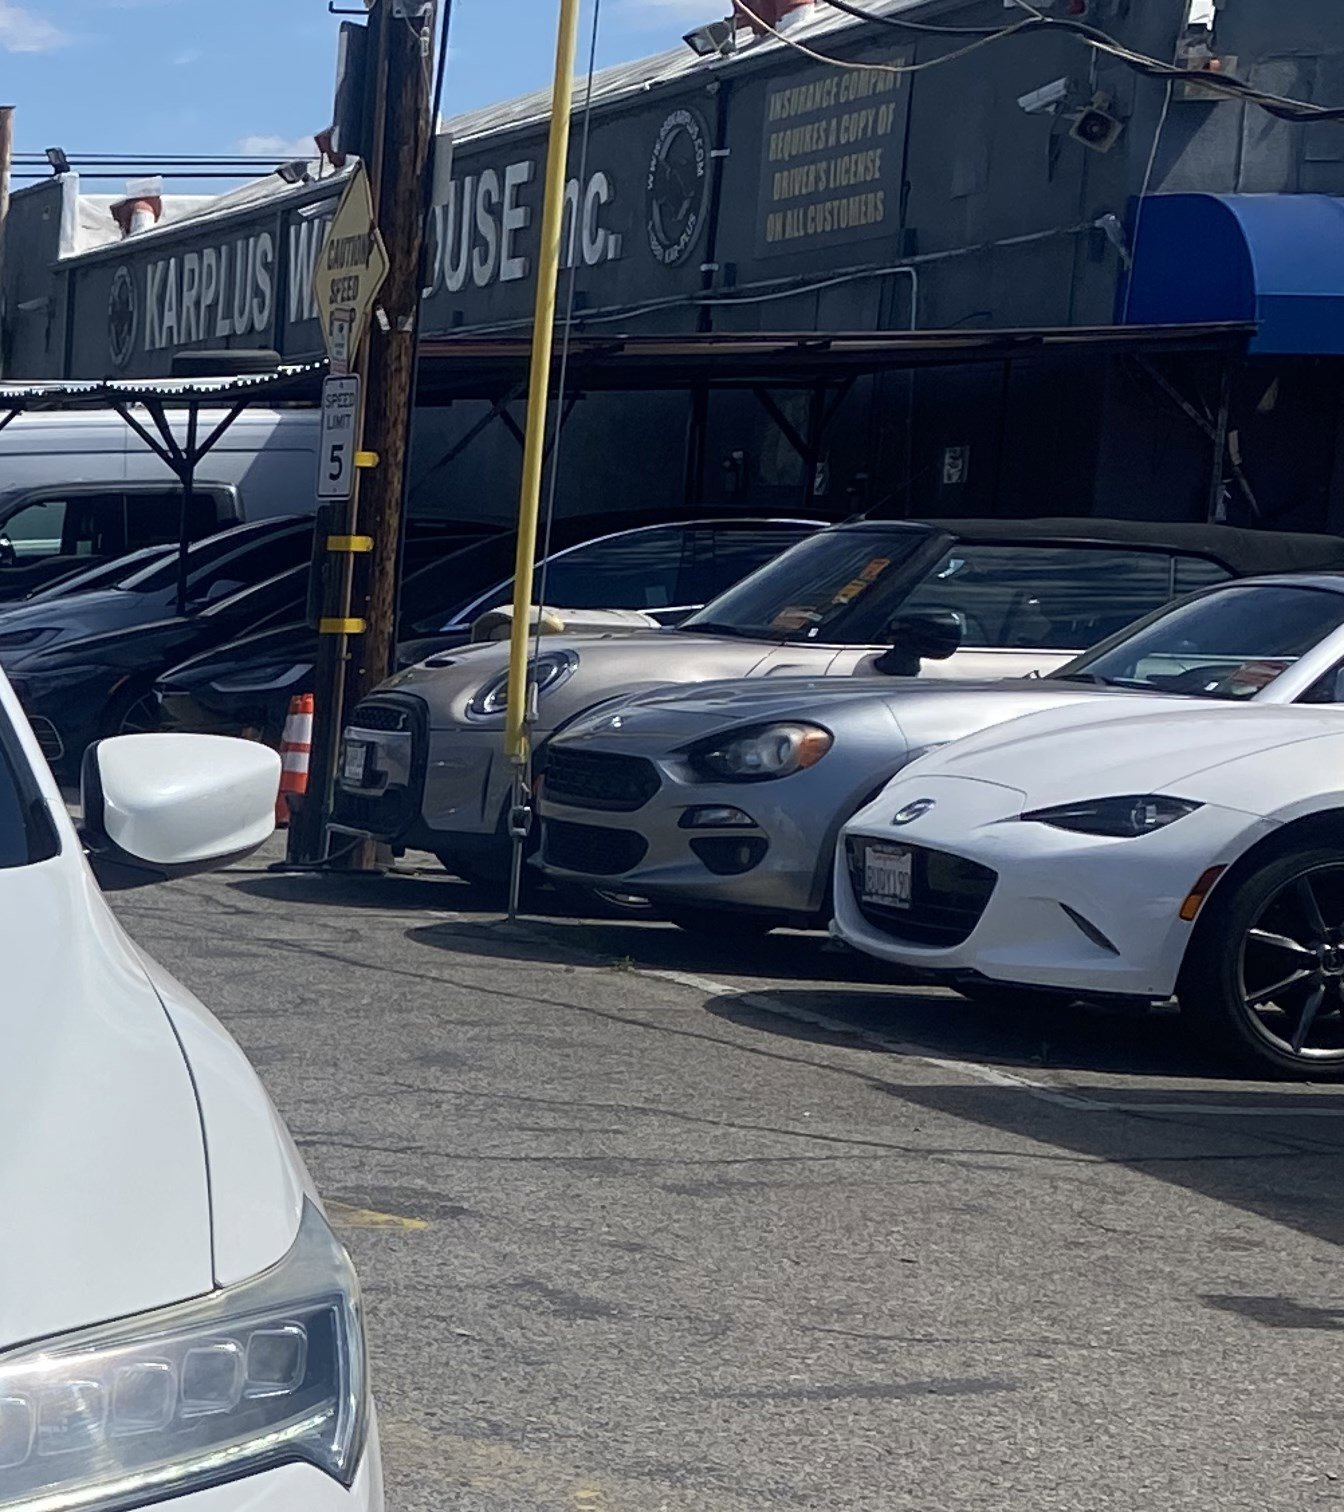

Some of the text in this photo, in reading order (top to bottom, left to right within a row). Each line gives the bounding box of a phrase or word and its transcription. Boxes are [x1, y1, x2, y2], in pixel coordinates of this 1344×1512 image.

[769, 58, 906, 121] INSURANCE COMPANY
[769, 102, 896, 162] REQUIRES A COPY OF
[773, 147, 883, 200] DRIVER'S LICENSE
[765, 190, 885, 242] ON ALL CUSTOMERS
[327, 231, 372, 271] CAUTION
[145, 232, 274, 351] KARPLUS
[330, 275, 360, 305] SPEED
[325, 392, 355, 409] SPEED
[326, 413, 352, 431] LIMIT
[328, 444, 345, 481] 5
